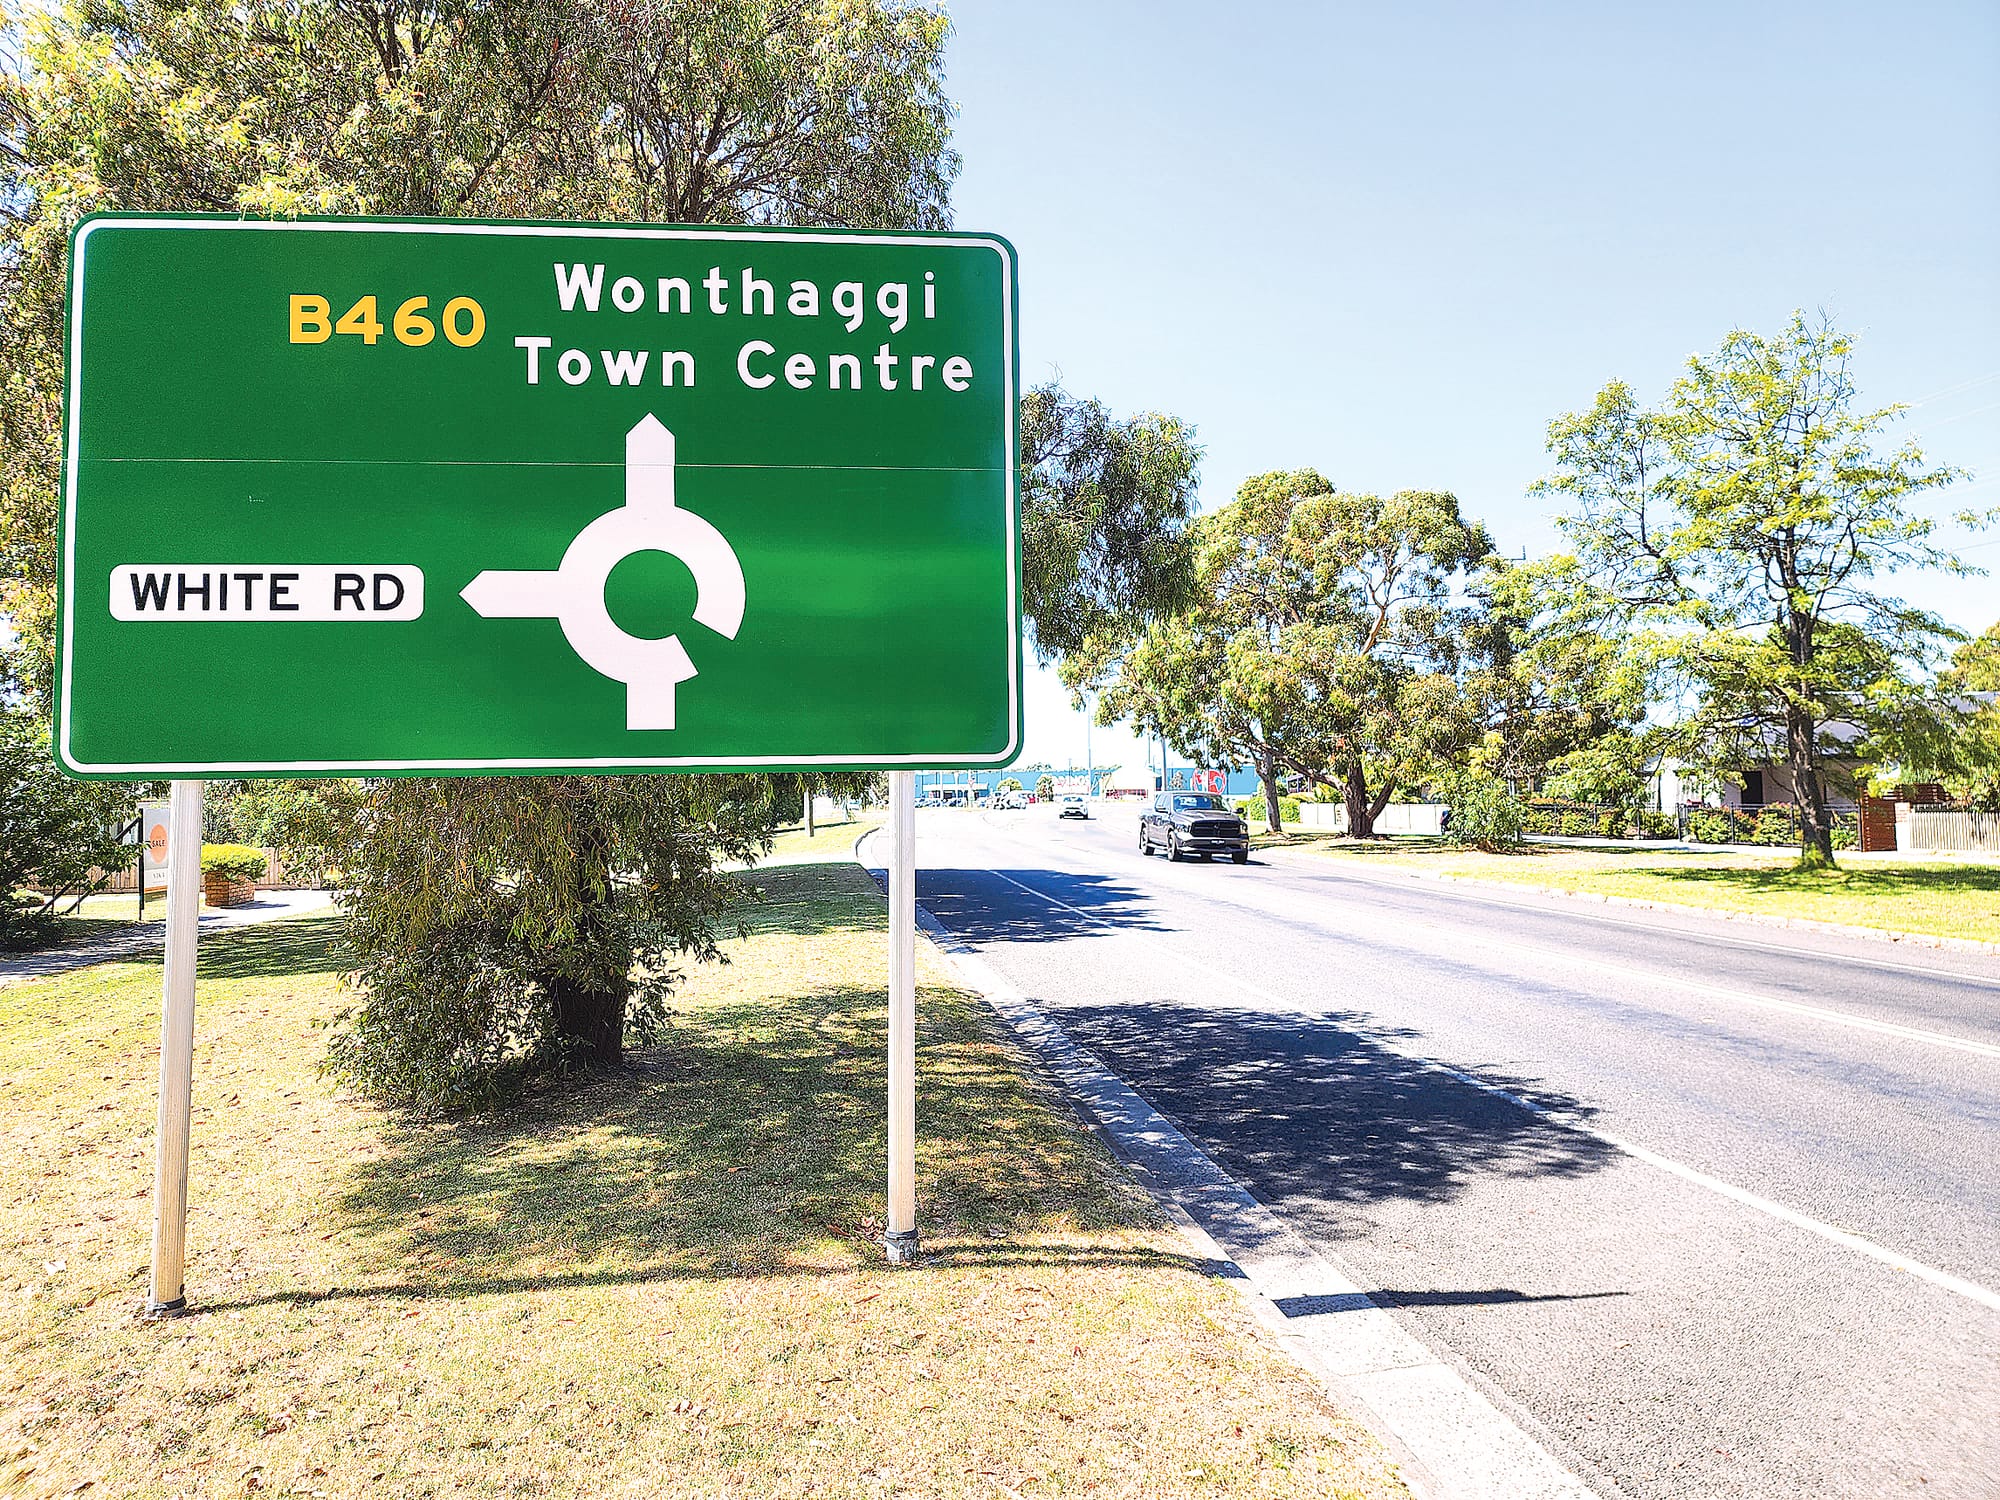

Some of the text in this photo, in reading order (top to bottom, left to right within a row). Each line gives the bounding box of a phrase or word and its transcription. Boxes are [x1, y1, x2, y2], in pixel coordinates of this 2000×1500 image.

[290, 294, 486, 348] B460
[553, 263, 936, 333] Wonthaggi
[514, 336, 973, 392] Town Centre
[129, 573, 405, 611] WHITE RD
